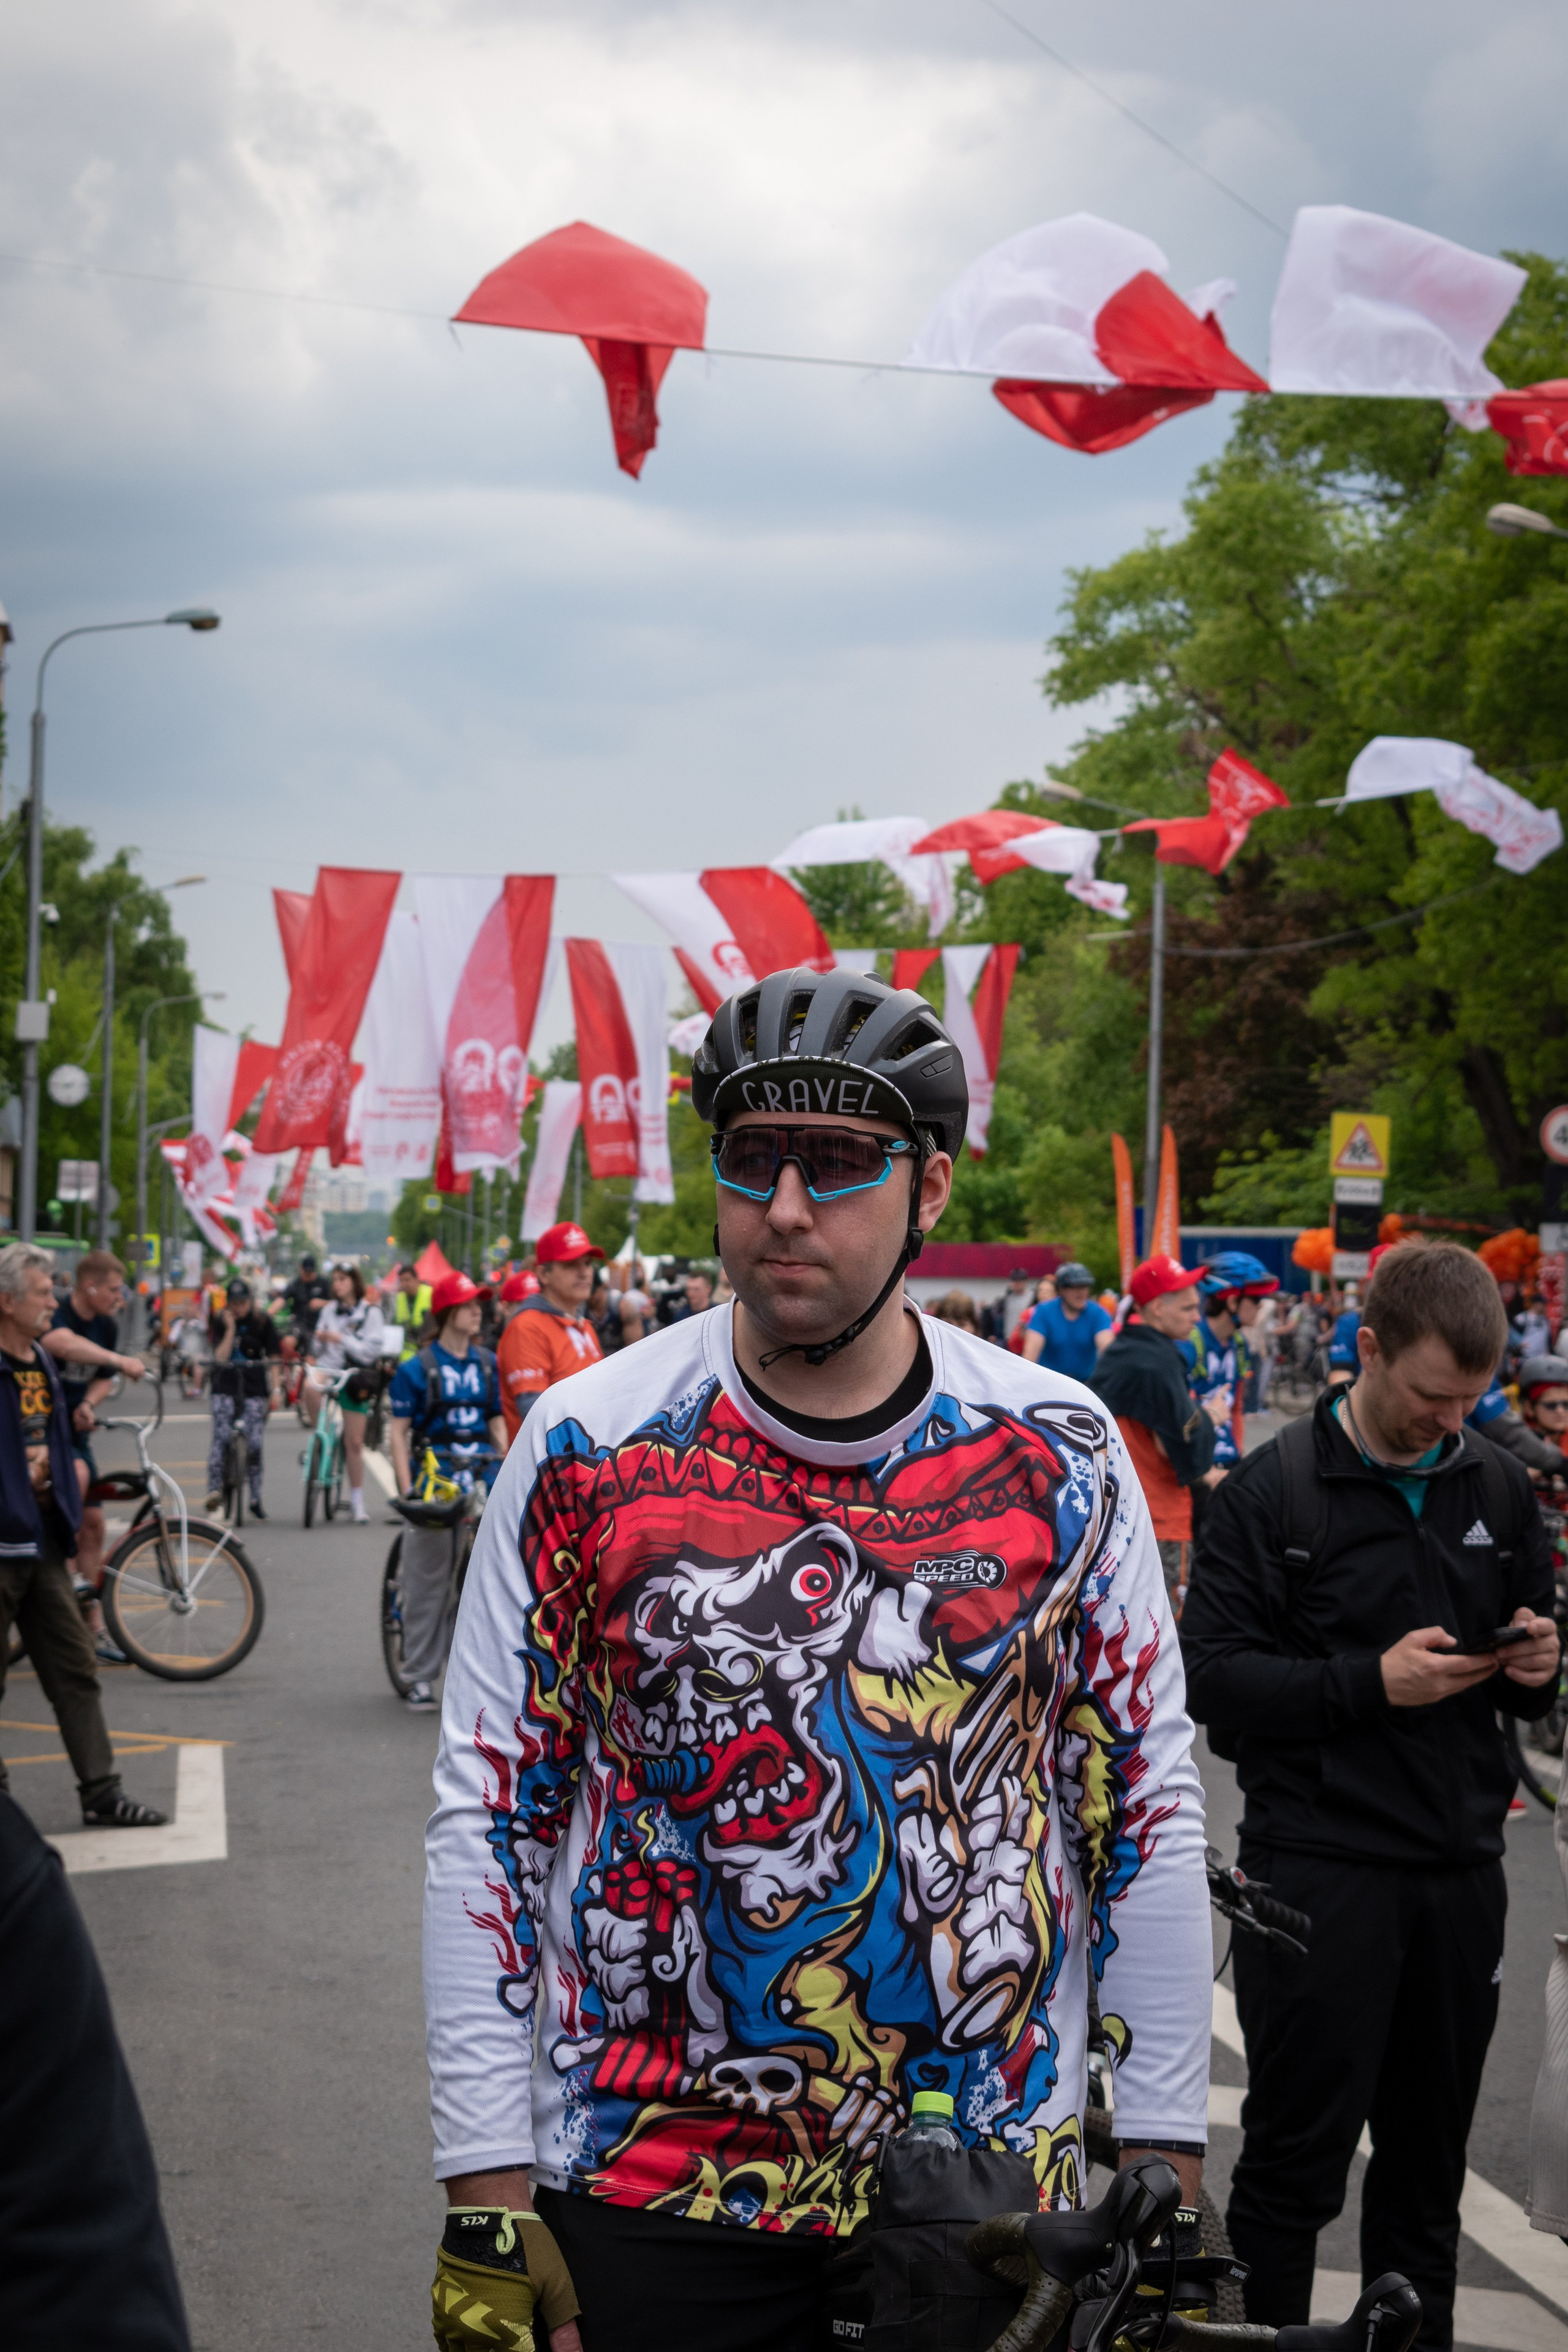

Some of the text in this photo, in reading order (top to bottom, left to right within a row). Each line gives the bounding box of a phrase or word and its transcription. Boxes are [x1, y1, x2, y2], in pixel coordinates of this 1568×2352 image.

[742, 1078, 880, 1114] GRAVEL
[913, 1556, 974, 1575] MPC
[913, 1573, 974, 1582] SPEED
[460, 2215, 489, 2226] KLS
[1175, 2212, 1196, 2223] KLS
[833, 2319, 865, 2339] GO FIT
